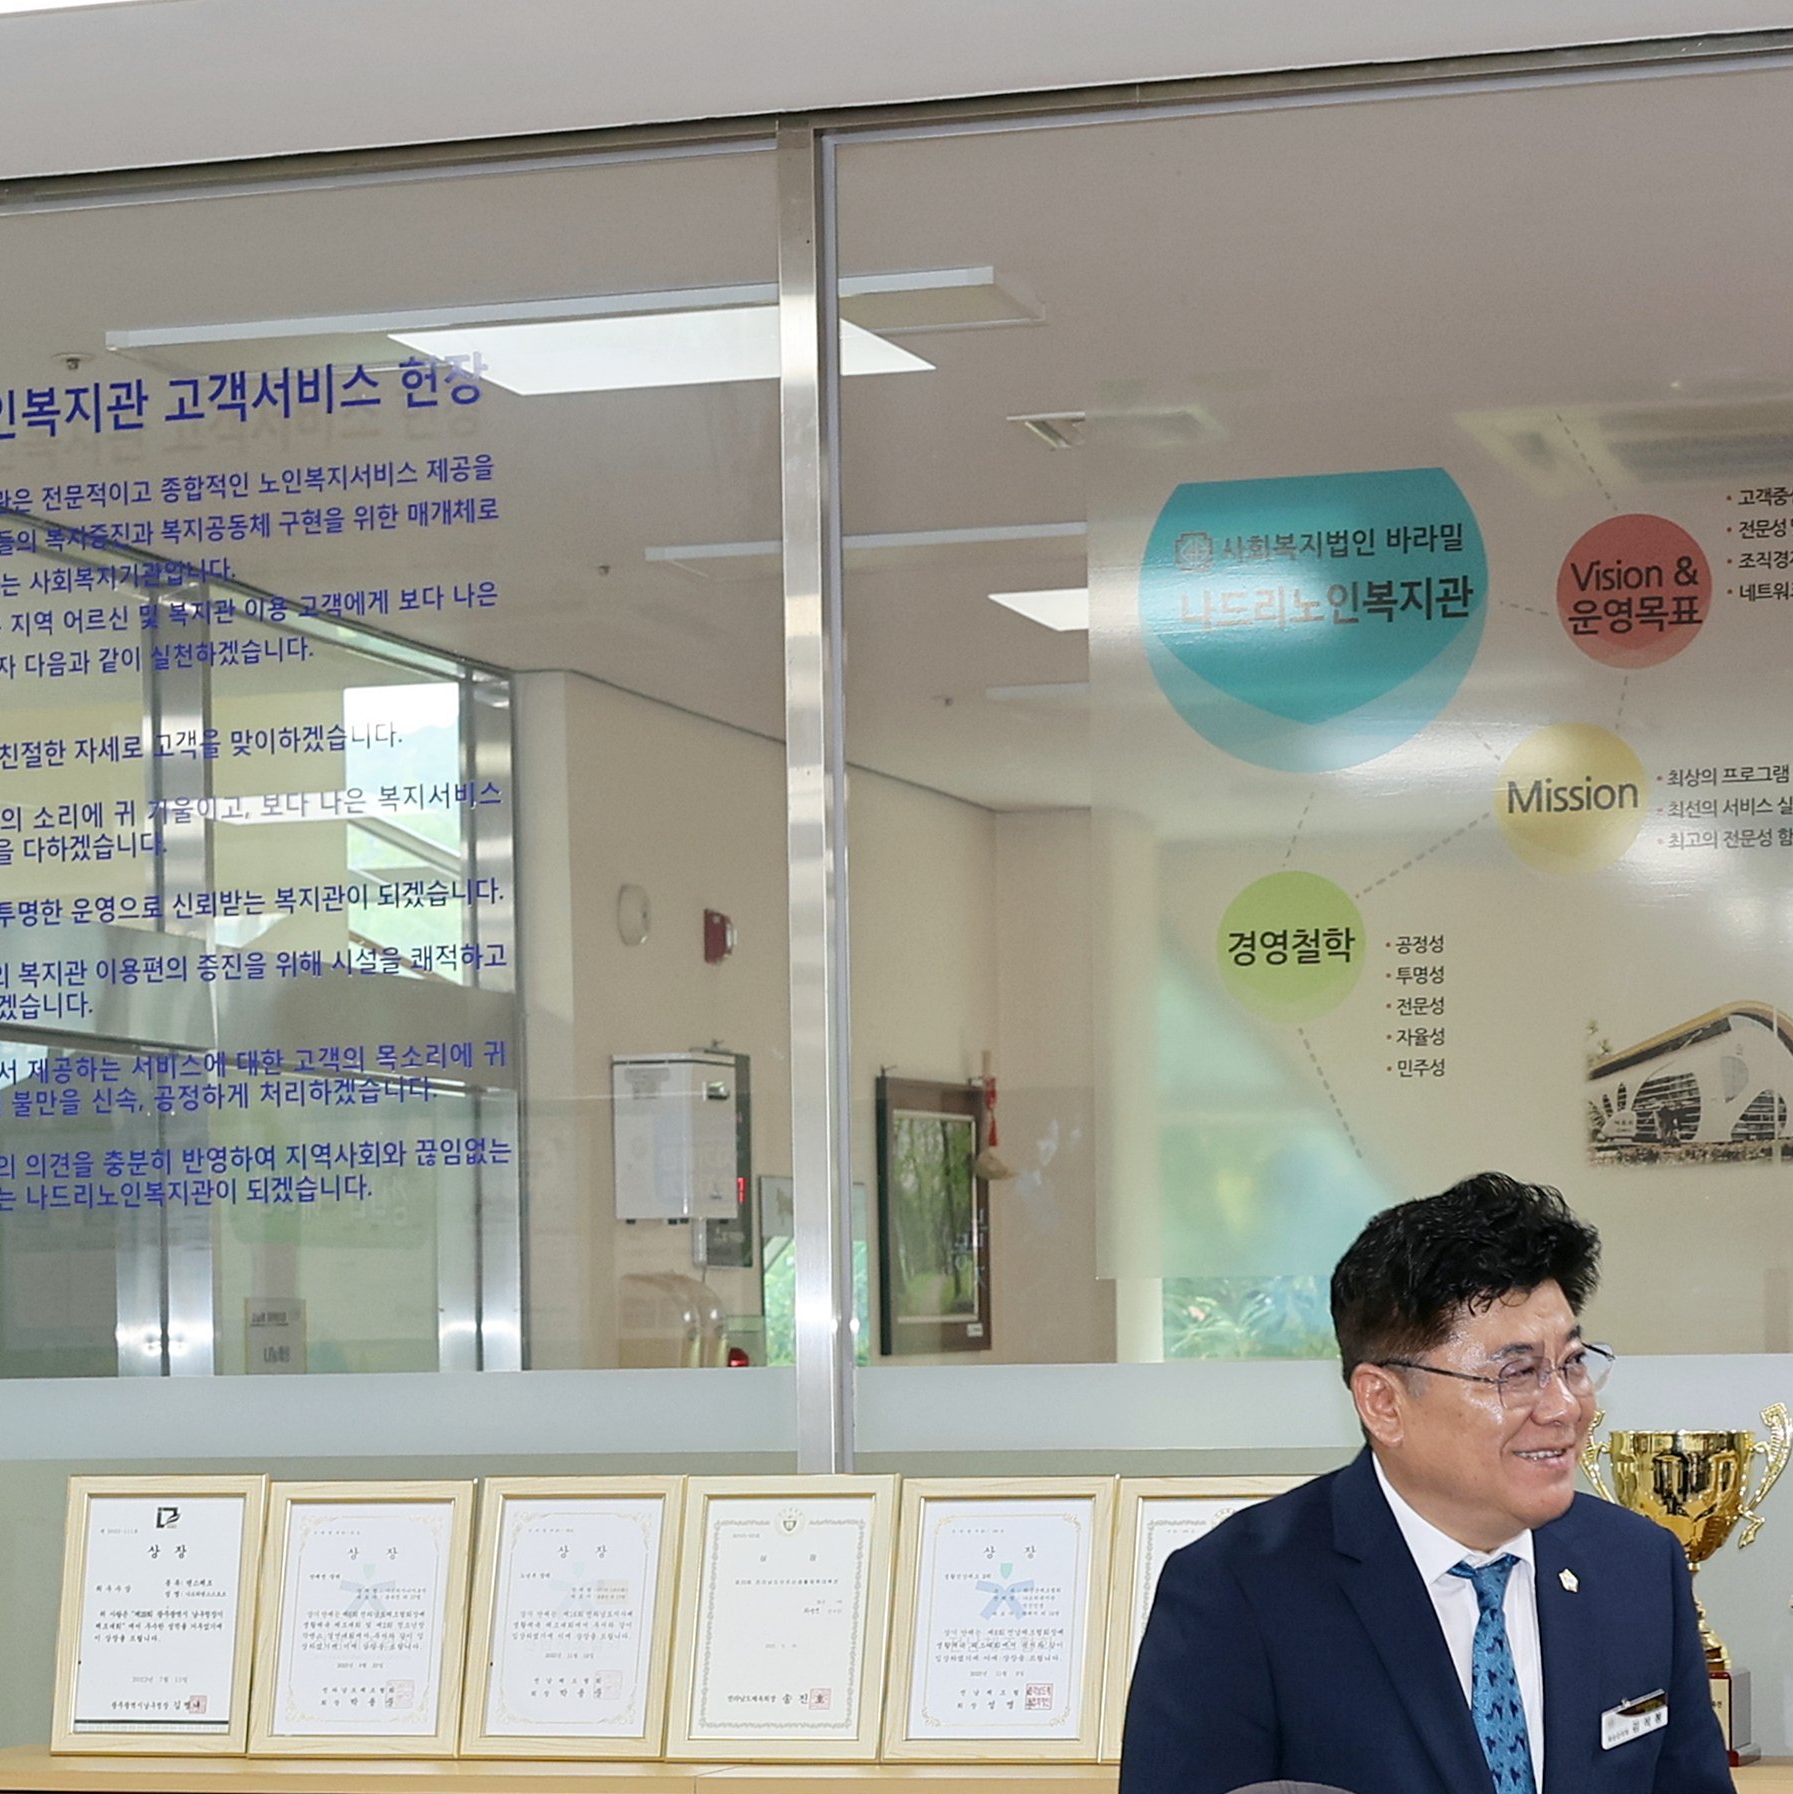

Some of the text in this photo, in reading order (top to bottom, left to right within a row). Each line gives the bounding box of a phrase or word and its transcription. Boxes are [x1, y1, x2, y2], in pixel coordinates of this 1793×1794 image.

[163, 359, 383, 428] 고객서비스
[398, 351, 488, 409] 헌장
[40, 477, 153, 513] 전문적이고
[160, 470, 249, 504] 종합적인
[257, 459, 419, 498] 노인복지서비스
[425, 453, 496, 487] 제공을
[159, 512, 272, 546] 복지공동체
[277, 507, 345, 538] 구현을
[351, 504, 399, 534] 위한
[406, 497, 498, 530] 매개체로
[1739, 519, 1787, 539] 전문성
[1223, 523, 1463, 559] 사회복지법인 바라밀
[1571, 556, 1698, 592] Vision &
[1182, 575, 1473, 630] 나드리노인복지관
[1568, 596, 1702, 635] 운영목표
[73, 733, 144, 768] 자세로
[1667, 767, 1717, 787] 최상의
[1722, 765, 1789, 784] 프로그램
[1507, 776, 1638, 814] Mission
[1668, 798, 1717, 819] 최선의
[1723, 797, 1772, 816] 서비스
[21, 831, 168, 866] 다하겠습니다.
[1668, 829, 1718, 850] 최고의
[1723, 828, 1772, 849] 전문성
[70, 893, 162, 926] 운영으로
[171, 888, 266, 921] 신뢰받는
[273, 882, 370, 916] 복지관이
[376, 876, 505, 911] 되겠습니다.
[1228, 927, 1355, 966] 경영철학
[1396, 935, 1445, 954] 공정성
[17, 958, 88, 990] 복지관
[94, 954, 189, 987] 이용편의
[196, 951, 268, 983] 증진을
[274, 948, 323, 980] 위해
[330, 945, 403, 978] 시설을
[409, 941, 508, 975] 쾌적하고
[1396, 966, 1445, 984] 투명성
[1396, 996, 1445, 1016] 전문성
[1396, 1028, 1445, 1046] 자율성
[1396, 1058, 1445, 1077] 민주성
[10, 1087, 82, 1119] 불만을
[90, 1085, 143, 1116] 신속,
[153, 1081, 252, 1114] 공정하게
[258, 1075, 439, 1110] 처리하겠습니다.
[23, 1148, 96, 1180] 의견을
[102, 1146, 172, 1178] 충분히
[179, 1143, 277, 1176] 반영하여
[284, 1140, 408, 1173] 지역사회와
[415, 1137, 512, 1170] 끊임없는
[26, 1177, 239, 1212] 나드리노인복지관이
[246, 1172, 373, 1205] 되겠습니다.
